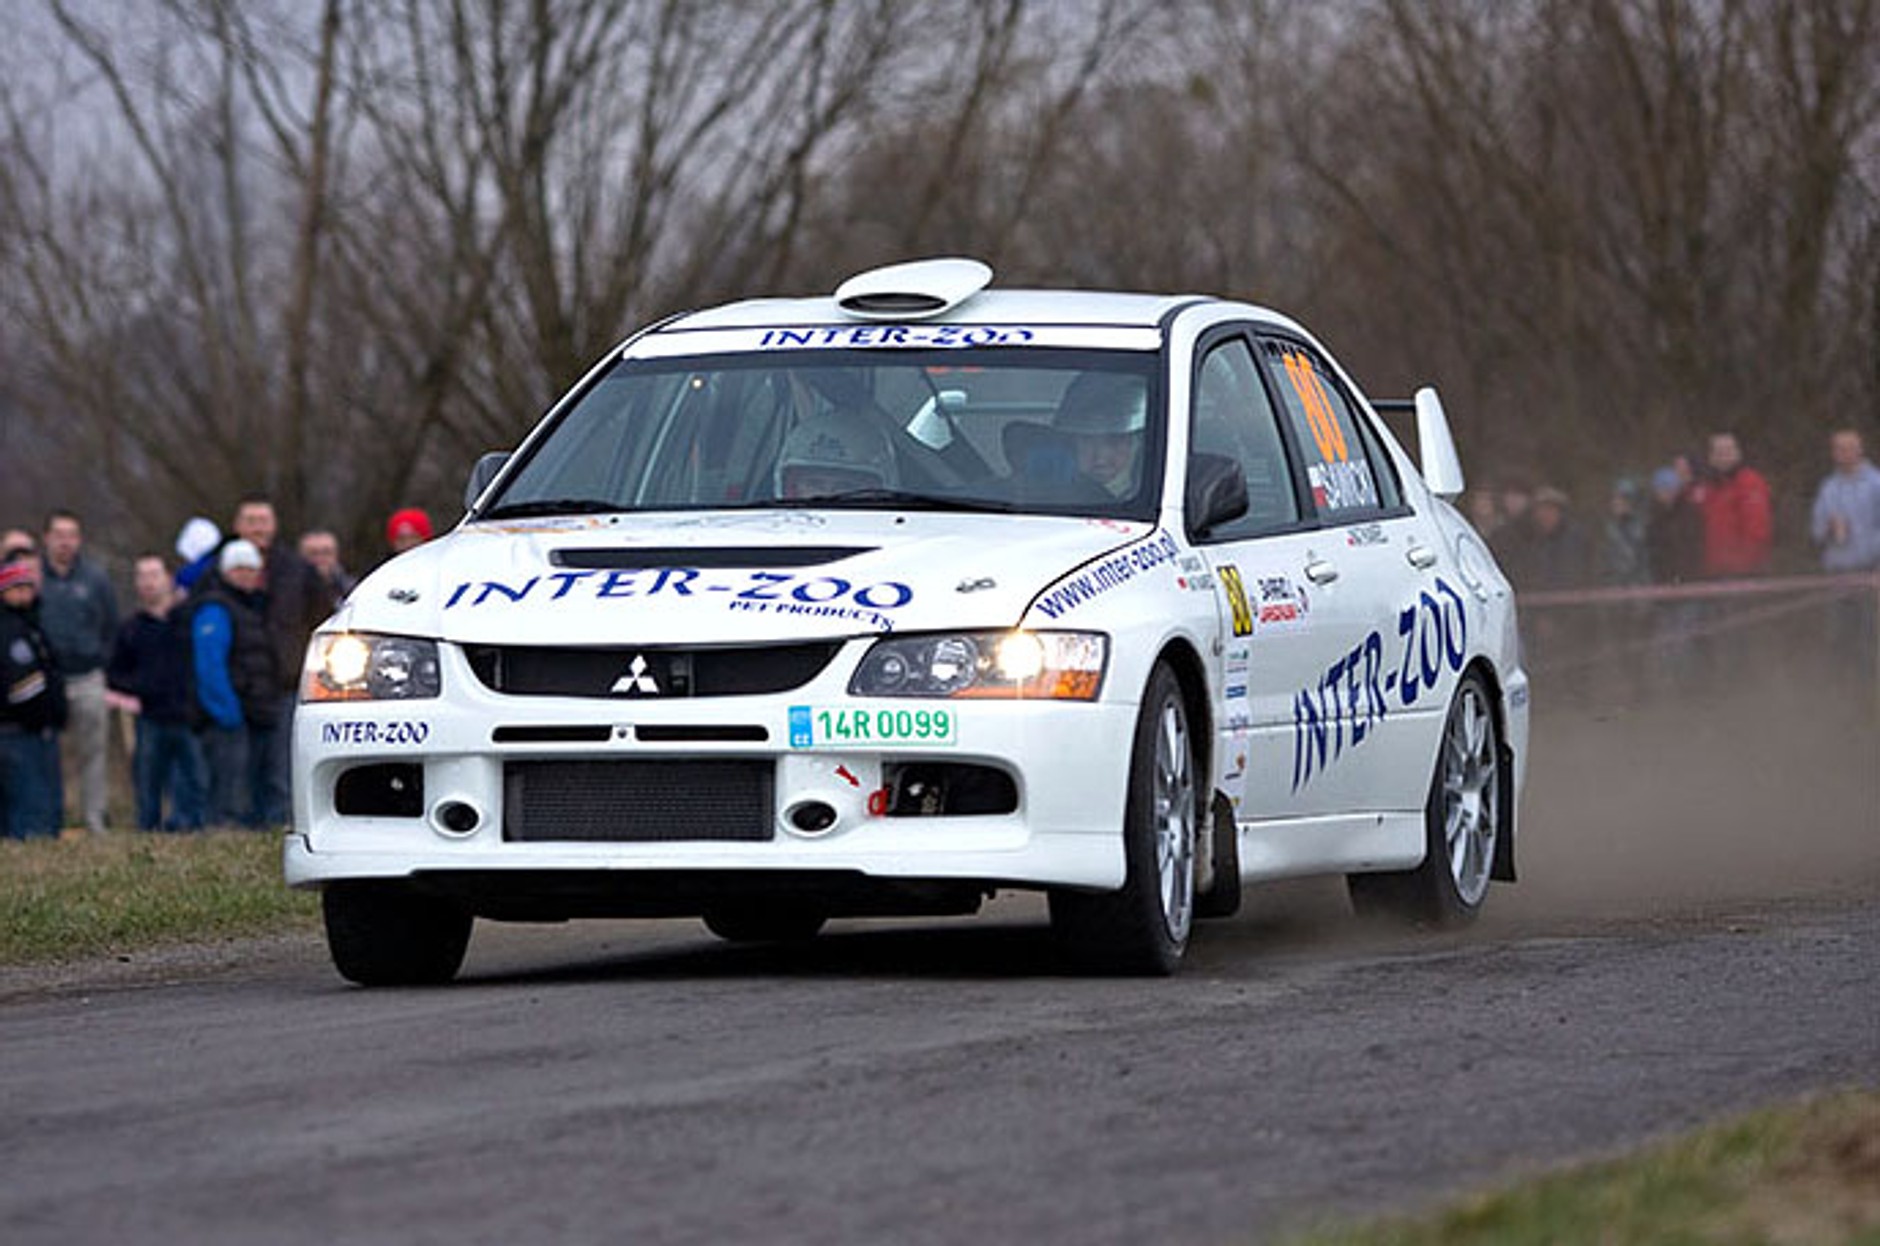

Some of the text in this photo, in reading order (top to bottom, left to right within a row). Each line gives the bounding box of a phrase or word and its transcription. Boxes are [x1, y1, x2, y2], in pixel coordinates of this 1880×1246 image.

[445, 568, 914, 609] INTER-ZOO
[1036, 527, 1181, 620] www.inter-zoo.pl
[729, 600, 895, 634] PET PRODUCTS
[1291, 577, 1467, 797] INTER-ZOO
[322, 721, 430, 744] INTER-ZOO
[818, 710, 950, 740] 14R 0099
